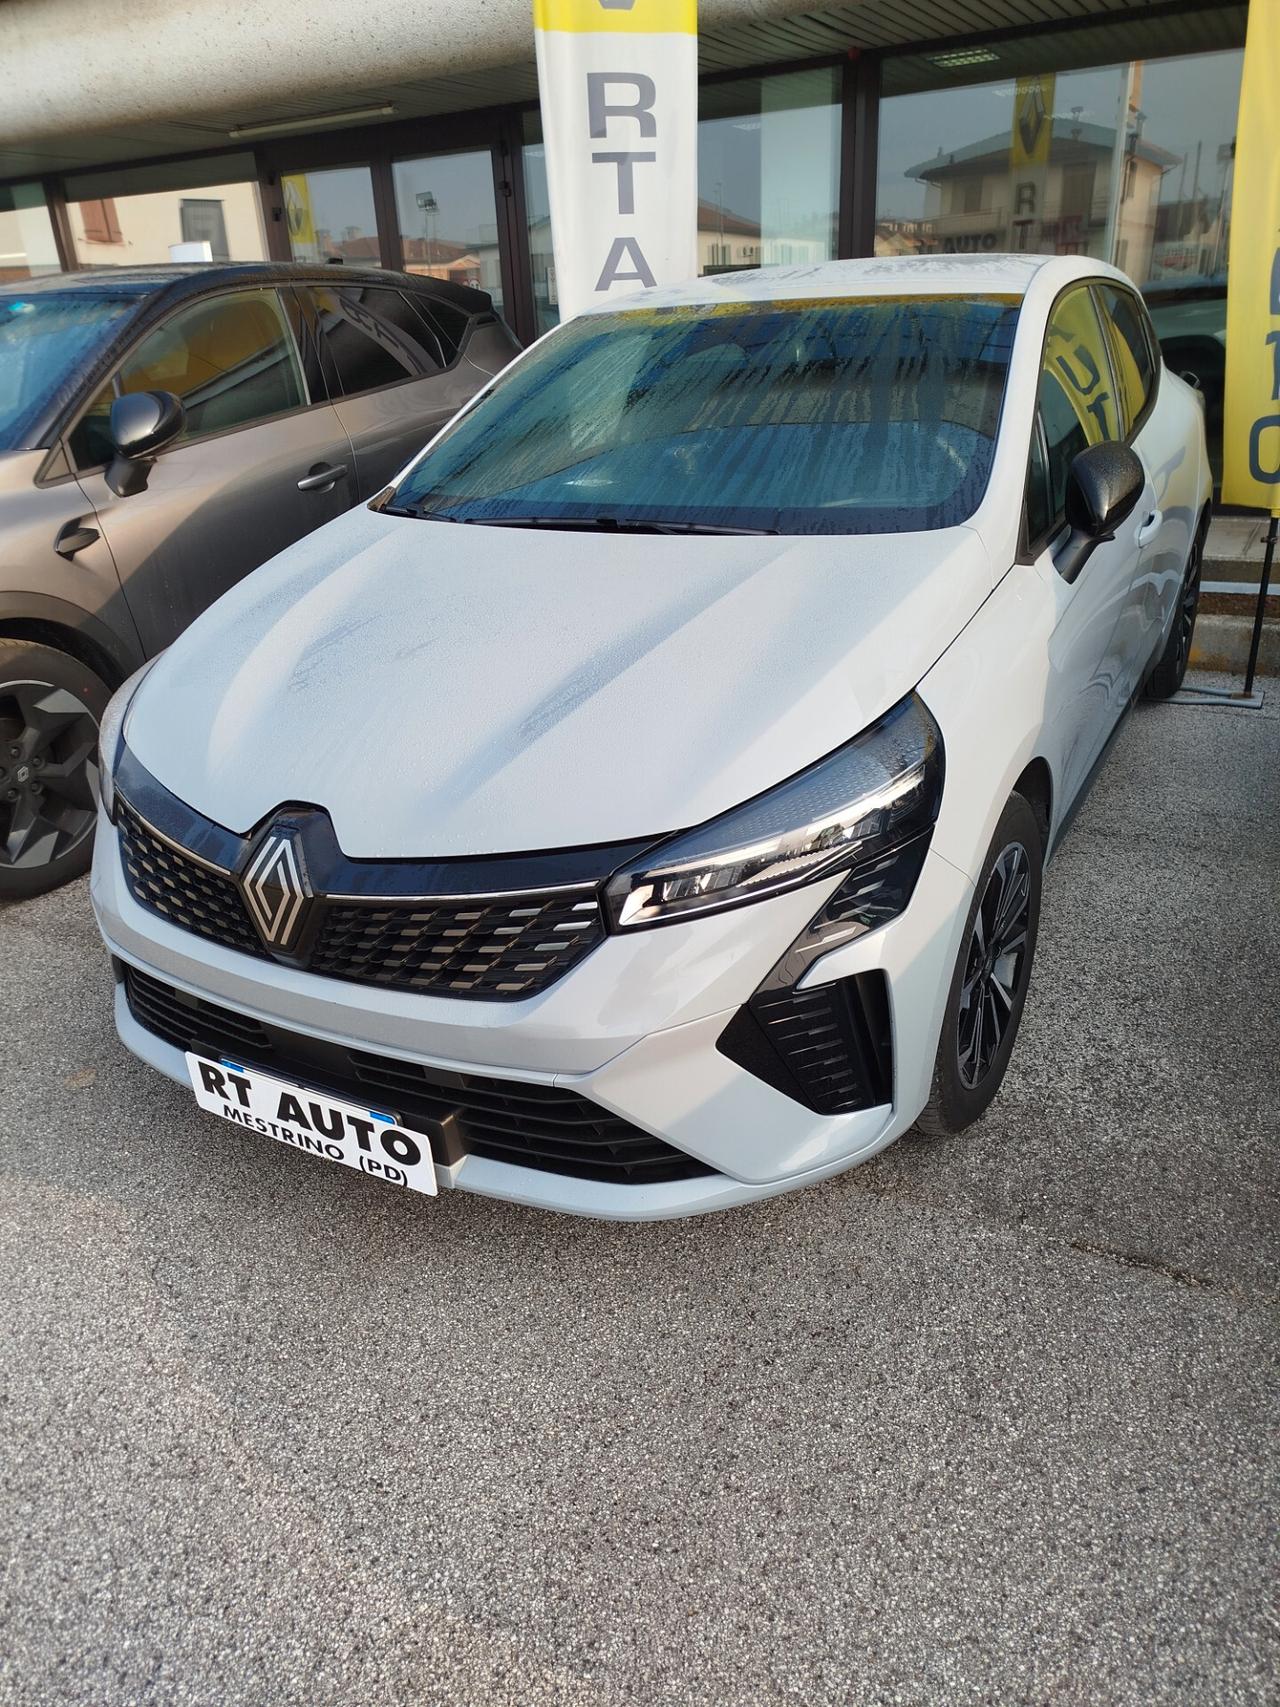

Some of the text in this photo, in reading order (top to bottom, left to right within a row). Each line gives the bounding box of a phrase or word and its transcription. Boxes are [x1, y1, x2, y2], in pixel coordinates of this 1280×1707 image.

[198, 1061, 421, 1166] RT AUTO
[223, 1104, 408, 1187] MESTRINO (PD)
